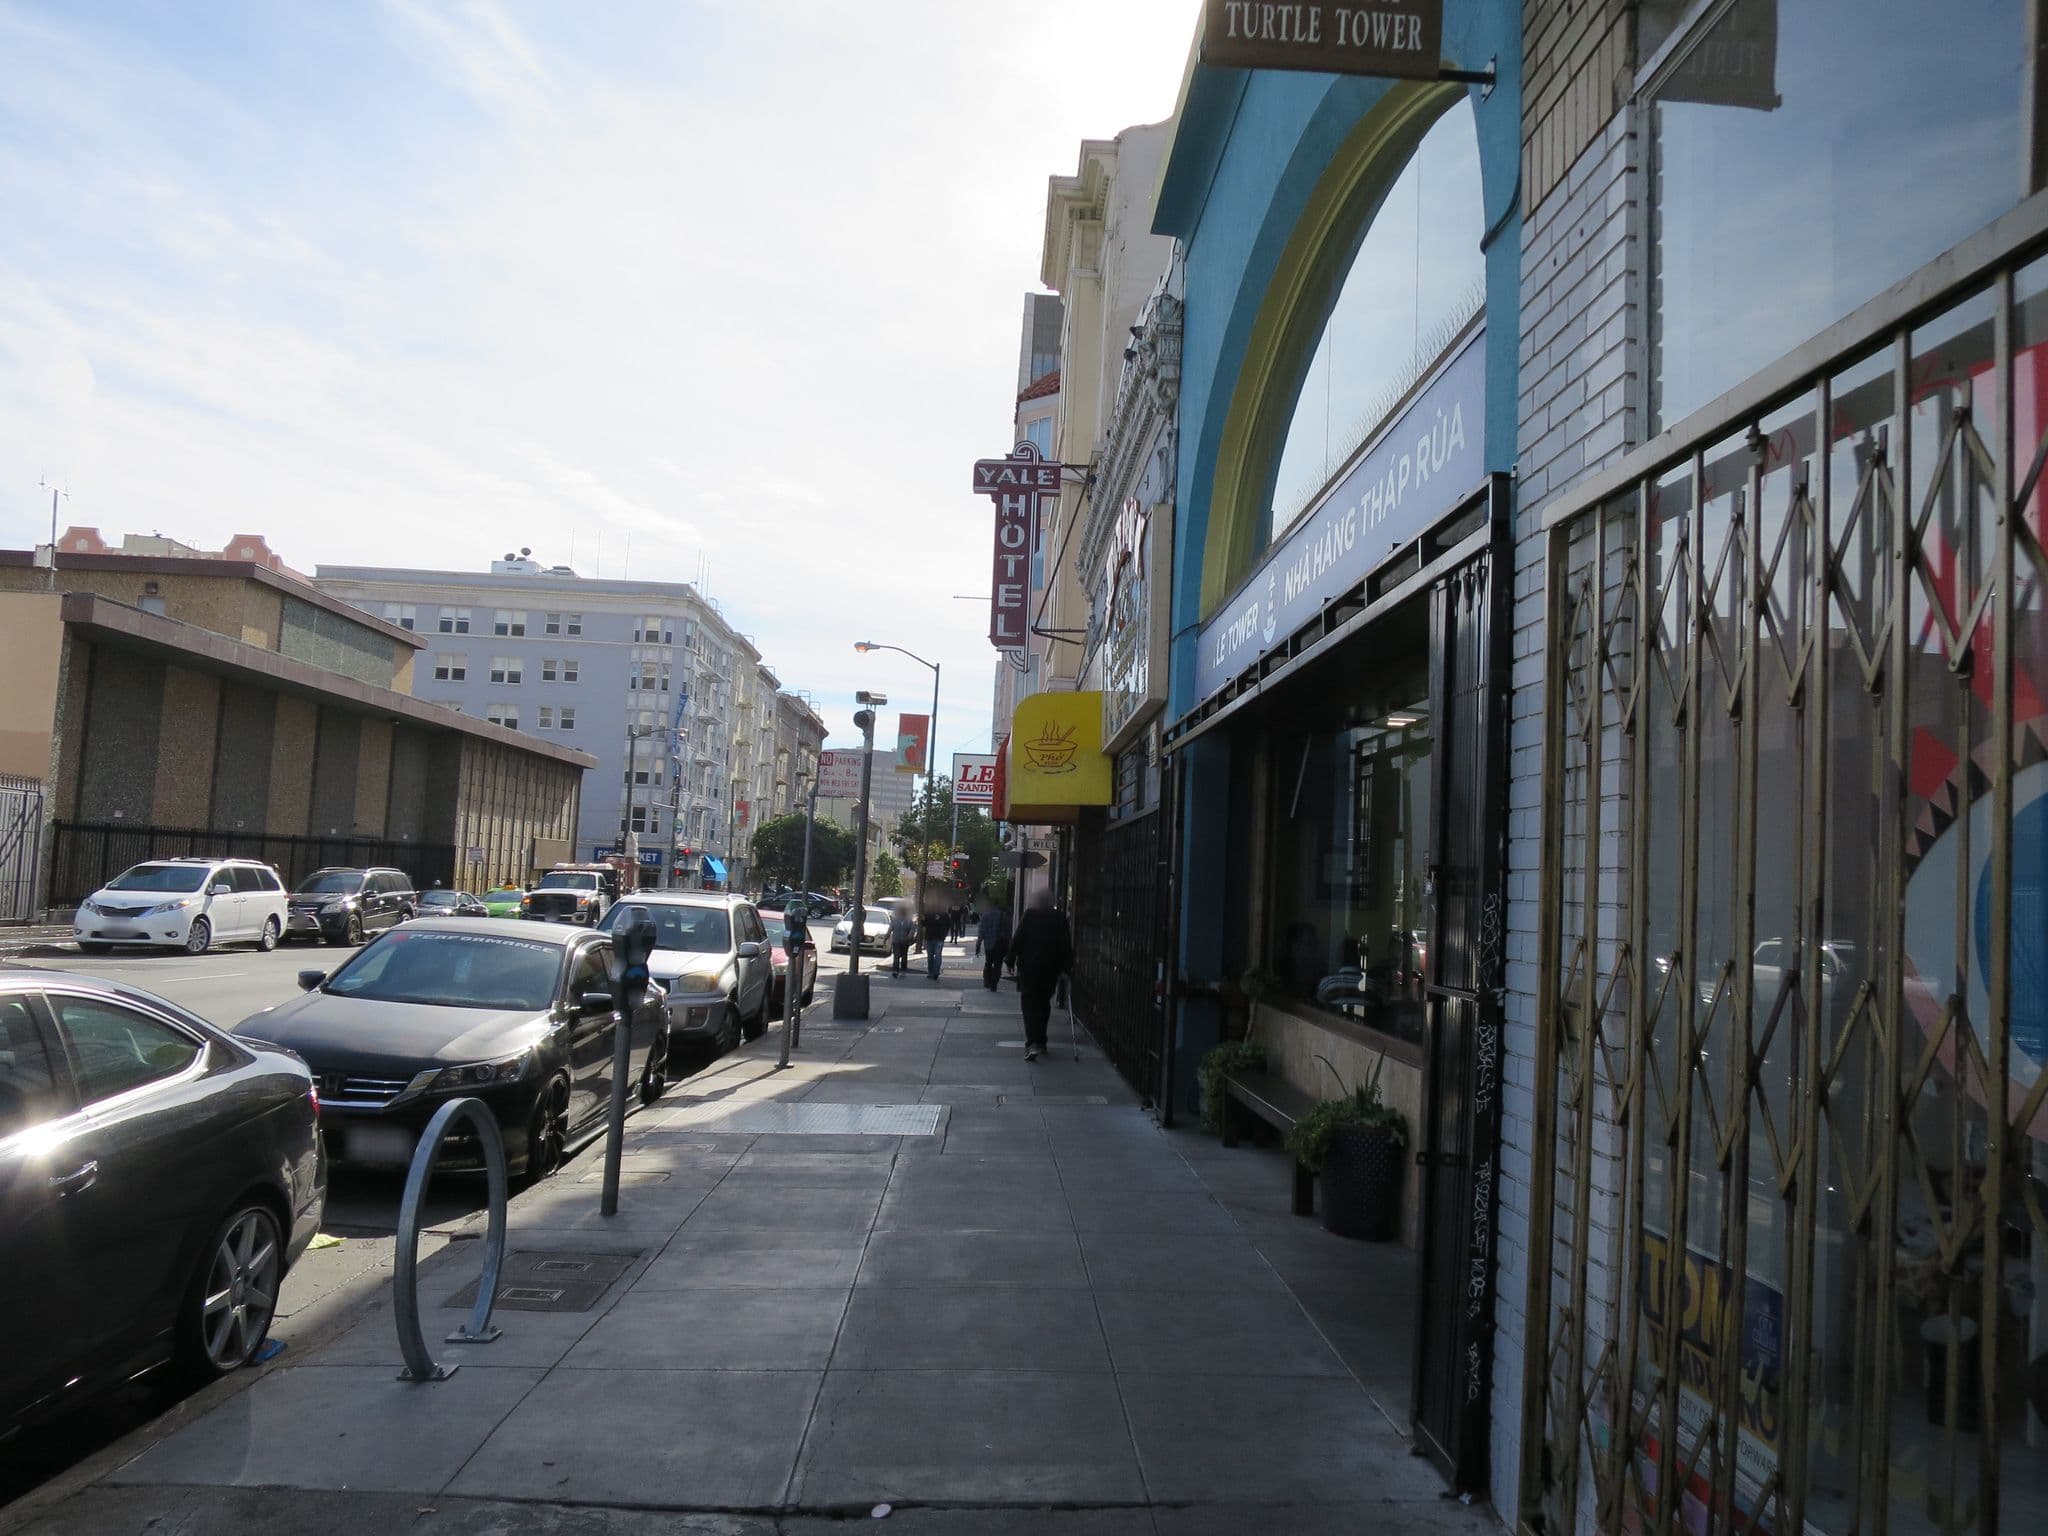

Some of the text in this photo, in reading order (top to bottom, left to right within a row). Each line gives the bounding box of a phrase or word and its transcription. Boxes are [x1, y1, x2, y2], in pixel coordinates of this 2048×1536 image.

[1225, 1, 1422, 50] TURTLE TOWER
[978, 467, 1054, 485] YALE
[1361, 454, 1410, 537] THÁP
[996, 494, 1026, 637] HOTEL
[1228, 601, 1259, 656] TOWER
[639, 851, 658, 862] KET
[409, 933, 556, 953] PERFORMANCE
